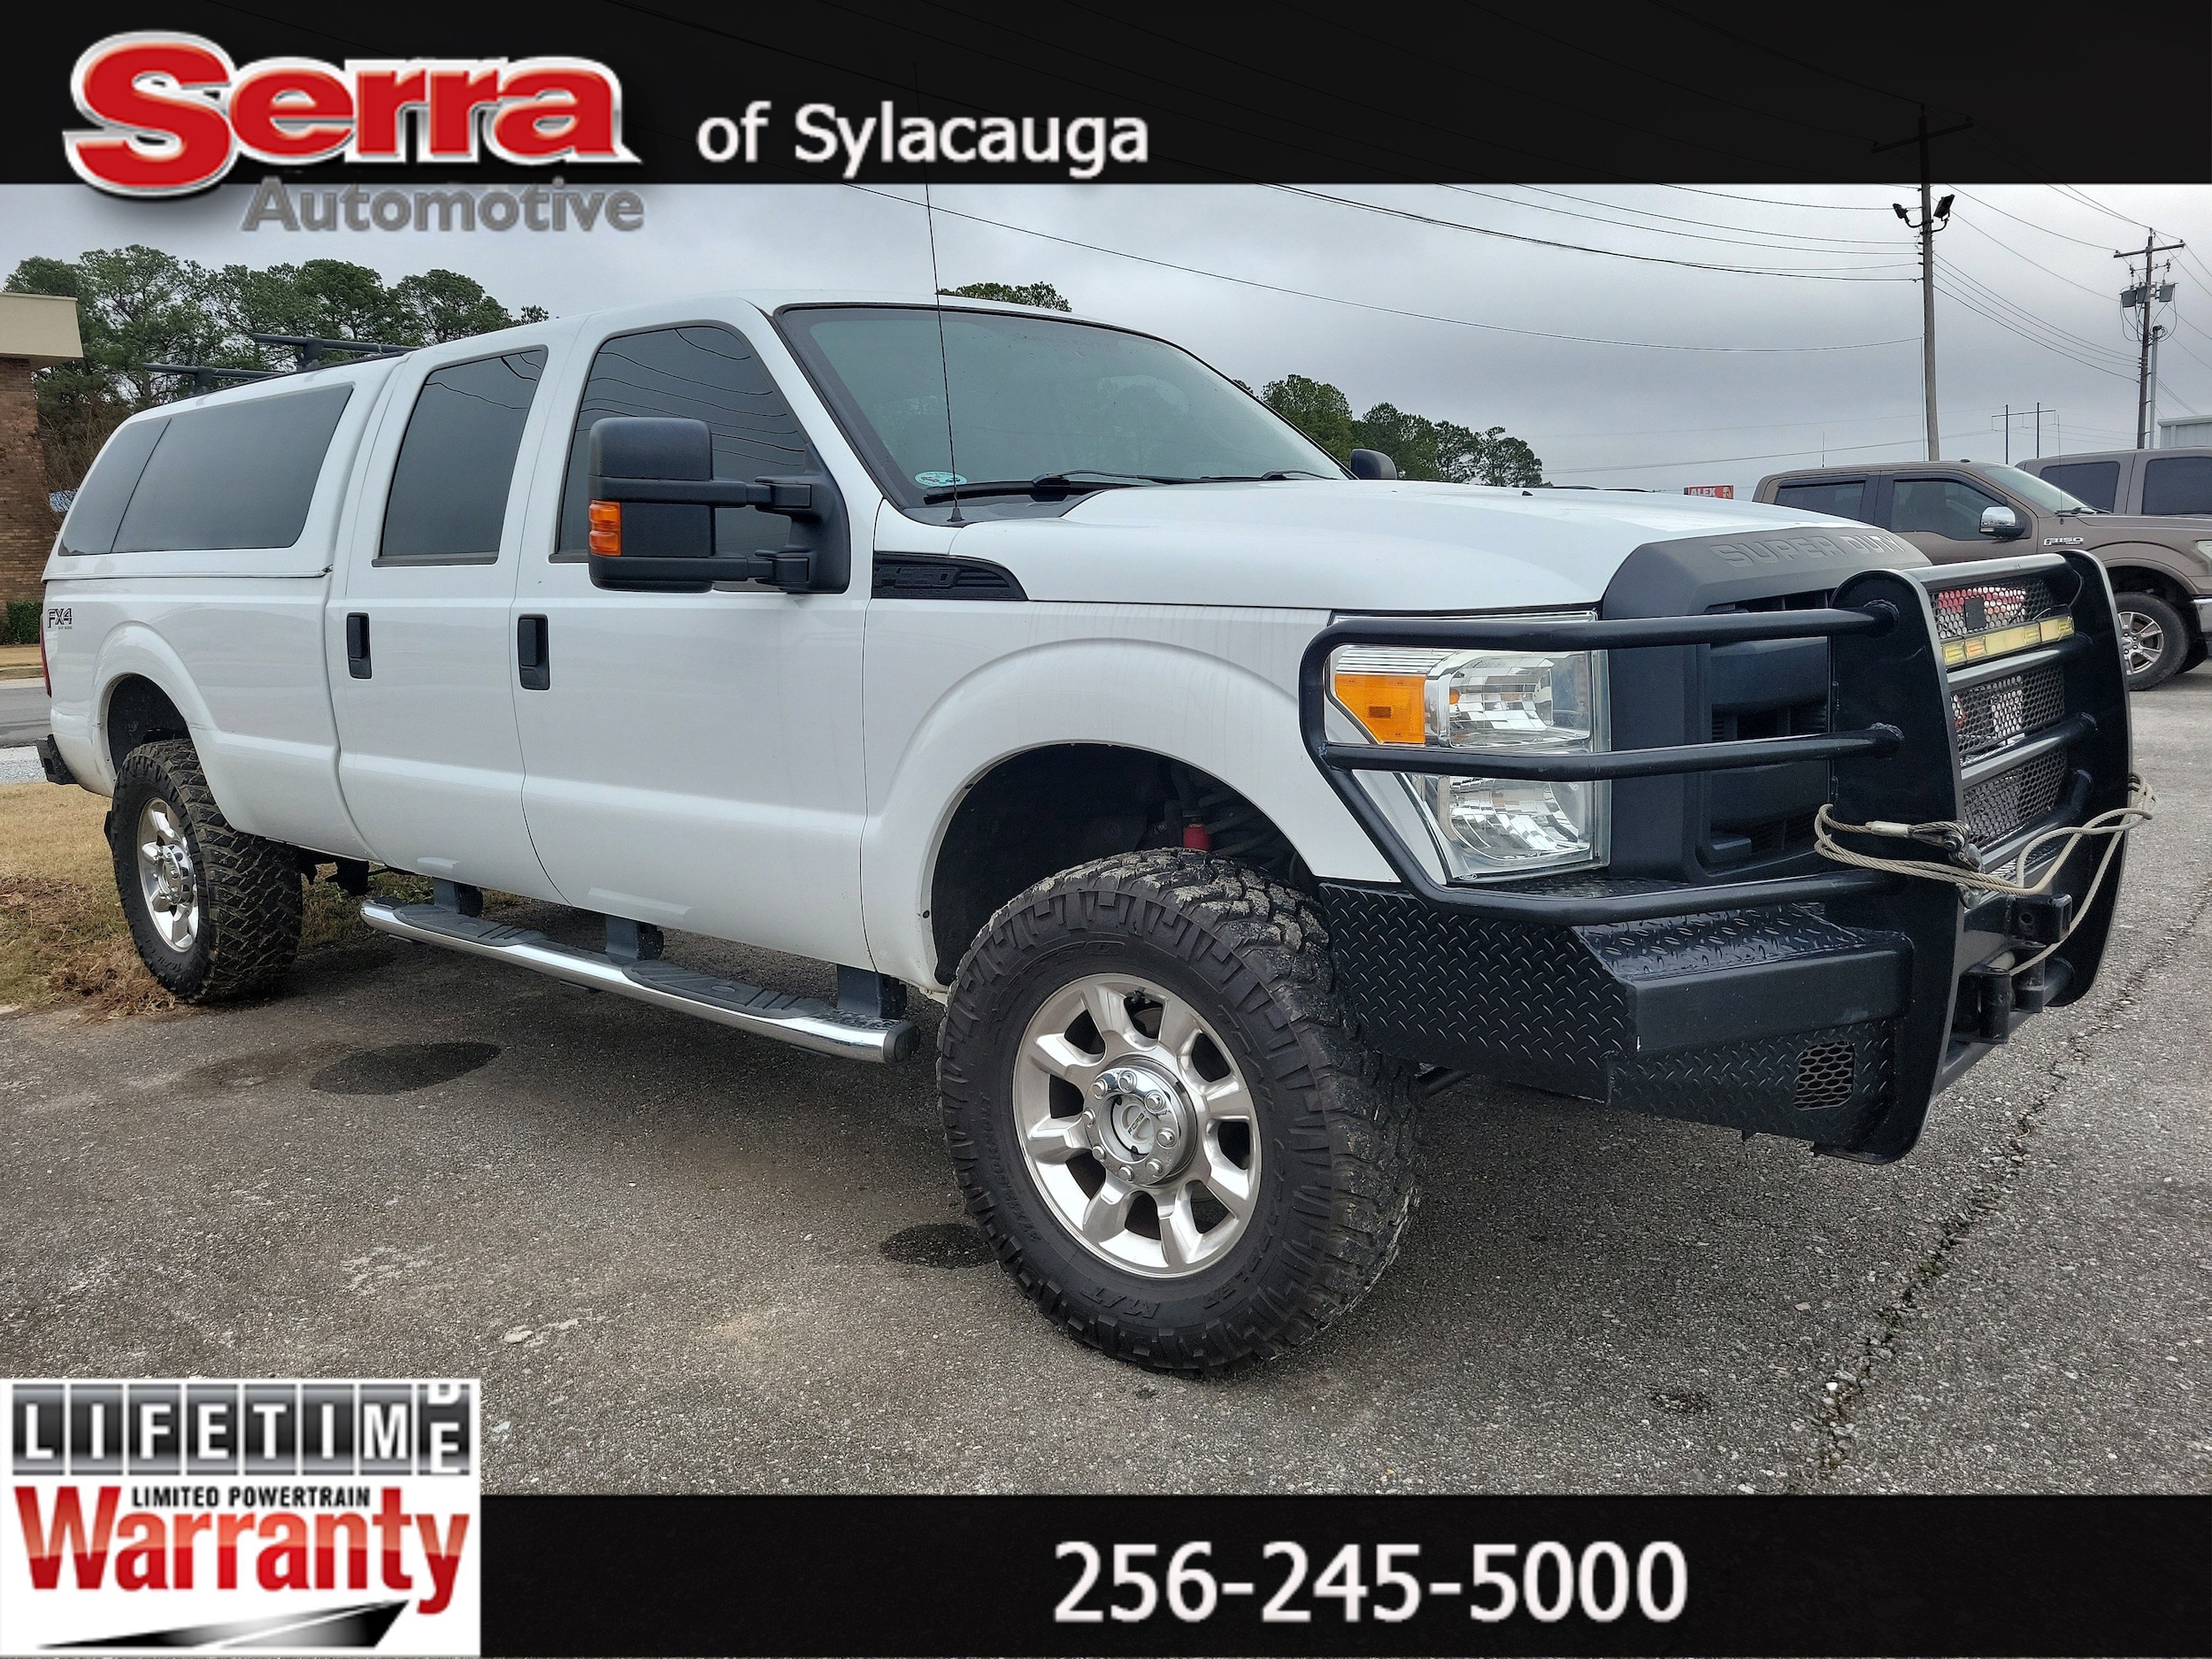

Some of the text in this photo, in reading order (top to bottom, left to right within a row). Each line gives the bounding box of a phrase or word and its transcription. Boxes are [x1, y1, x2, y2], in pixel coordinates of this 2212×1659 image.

[1709, 535, 1905, 568] SUPER DUTY
[47, 608, 73, 629] FX4
